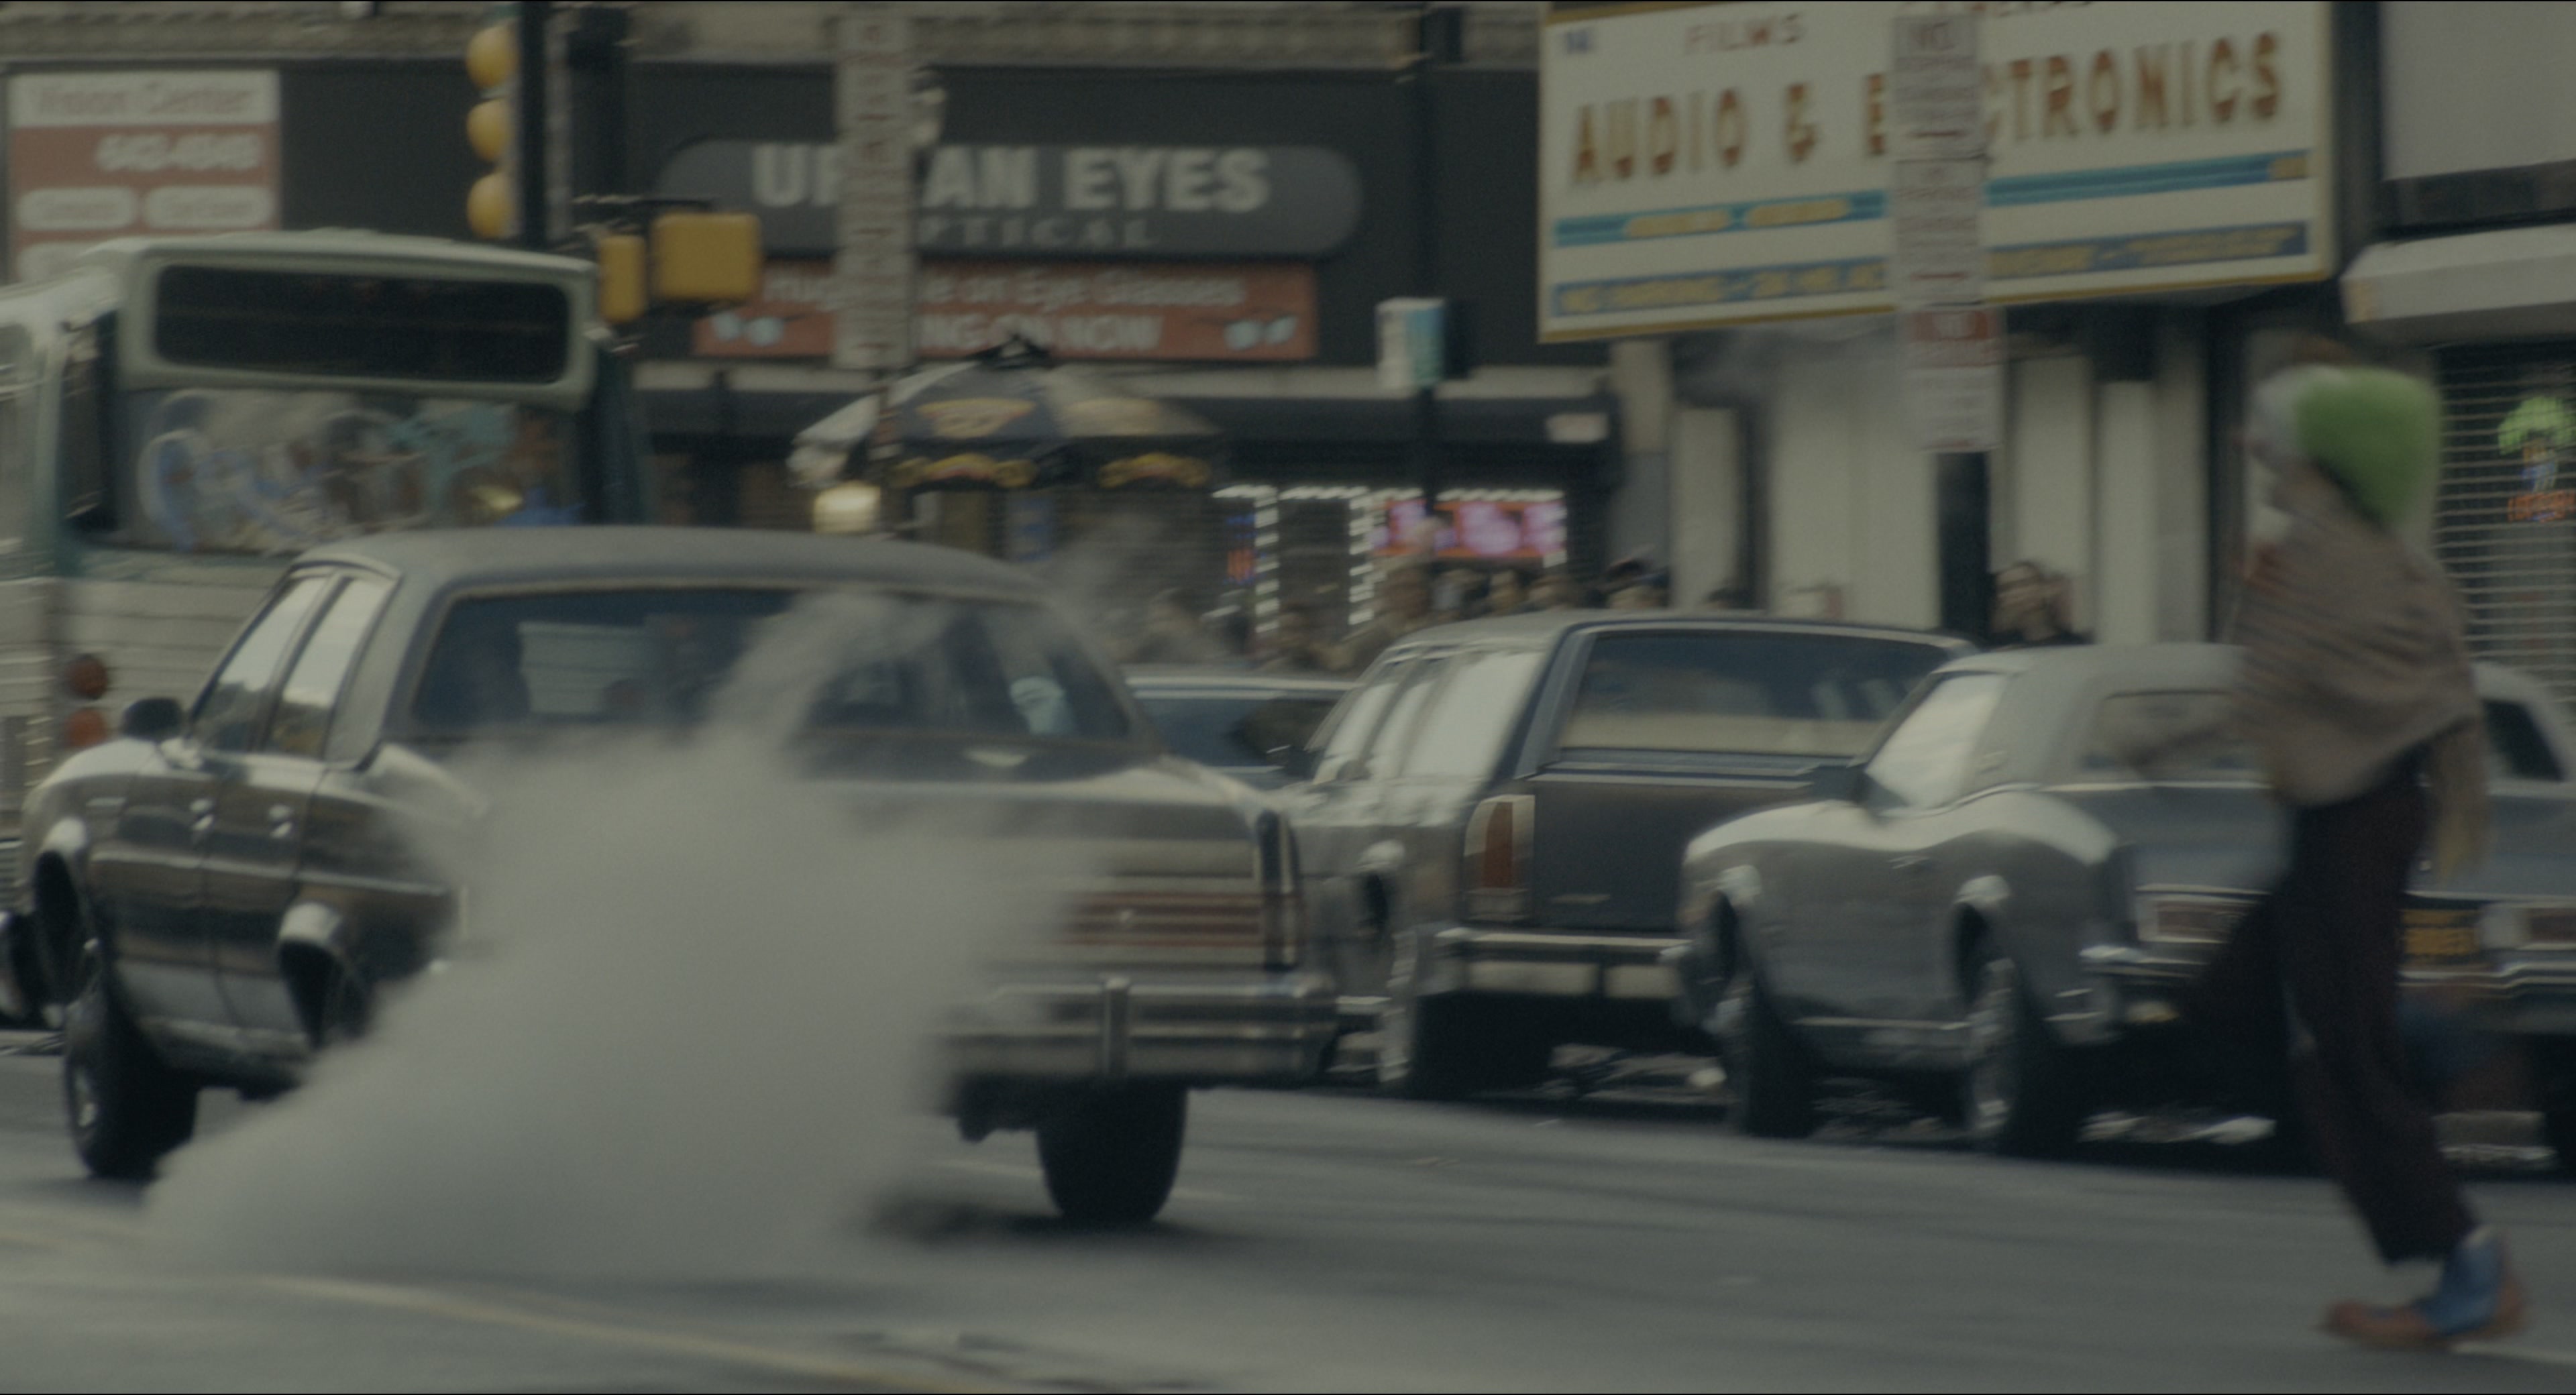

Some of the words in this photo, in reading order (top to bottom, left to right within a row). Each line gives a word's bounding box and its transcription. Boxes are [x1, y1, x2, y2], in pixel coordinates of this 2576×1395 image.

[1684, 11, 1805, 55] FILMS
[1572, 86, 1748, 185] AUDIO
[1782, 80, 1819, 165] &
[1864, 31, 2282, 162] ECTRONICS
[749, 142, 1041, 209] UAN
[1063, 144, 1272, 213] EYES
[915, 213, 1161, 249] PTICAL
